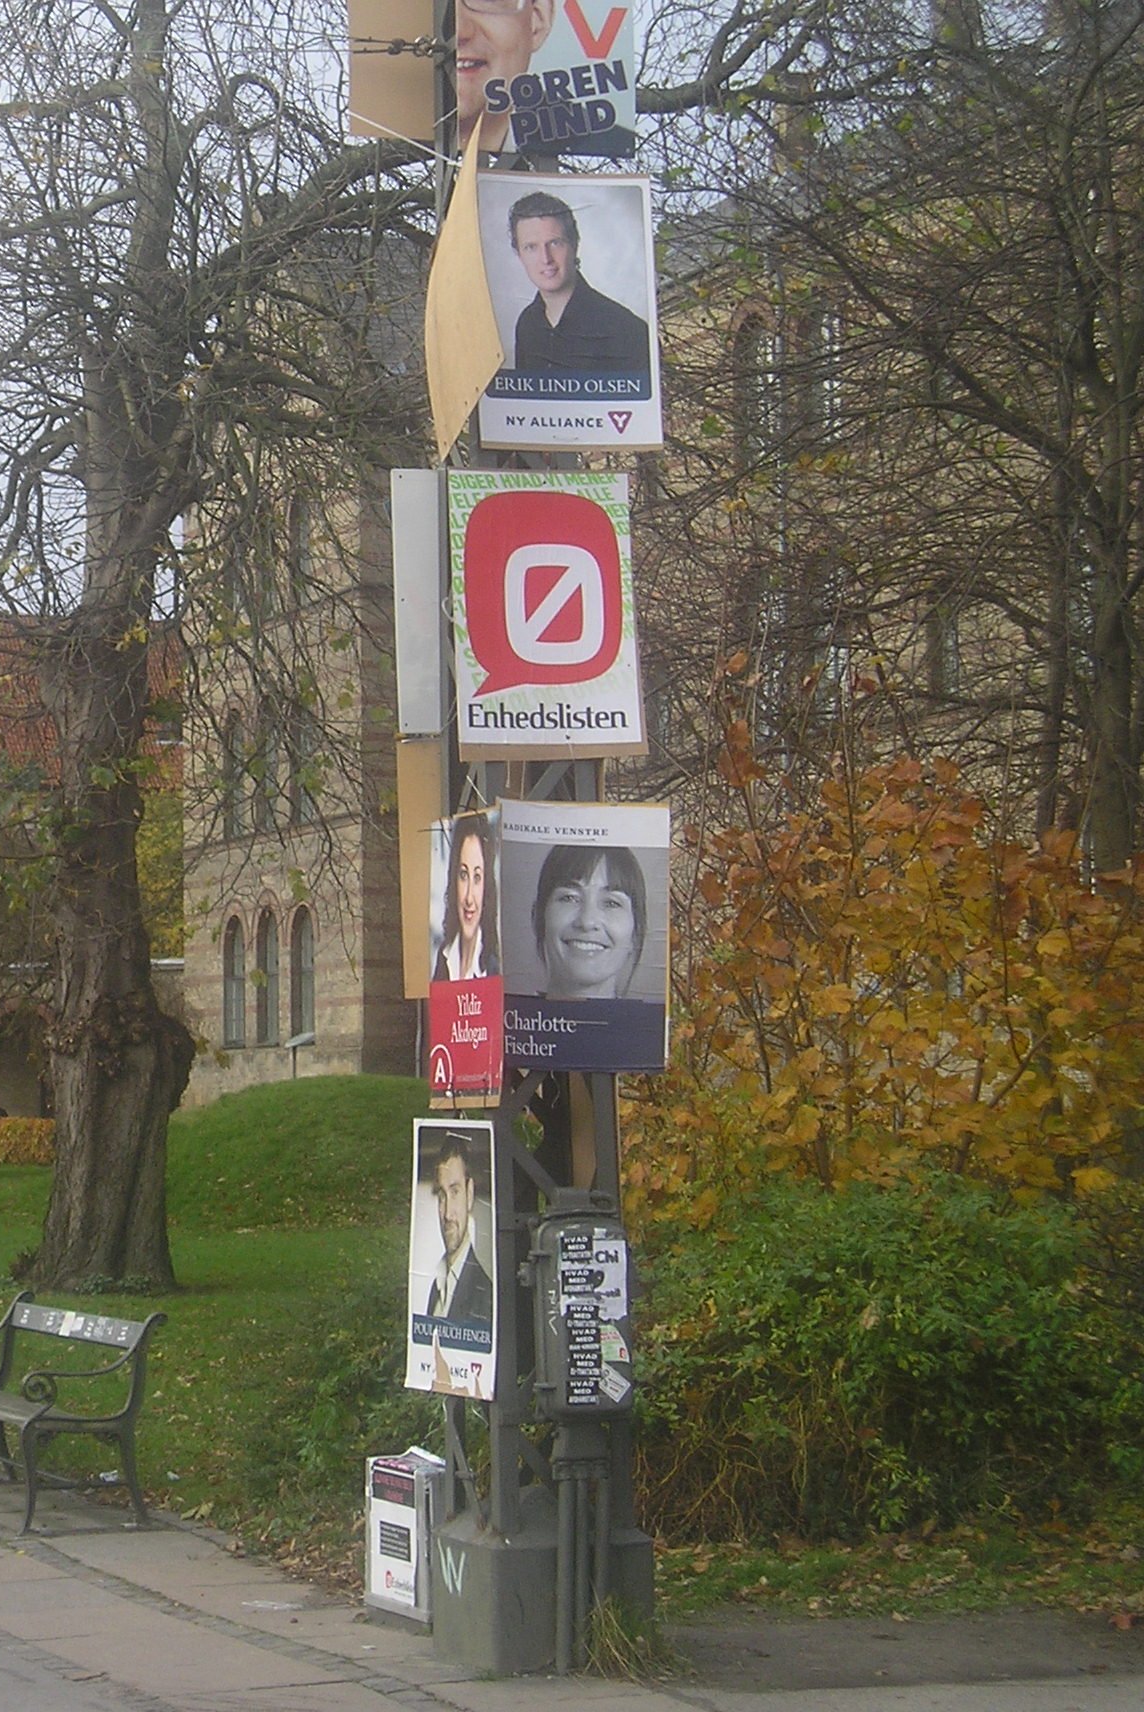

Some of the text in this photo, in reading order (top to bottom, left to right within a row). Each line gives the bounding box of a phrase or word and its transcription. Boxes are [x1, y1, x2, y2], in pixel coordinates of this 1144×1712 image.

[563, 0, 628, 59] V
[485, 60, 628, 112] SØREN
[510, 99, 616, 147] PIND
[494, 376, 641, 393] ERIK LIND OLSEN
[506, 415, 525, 426] NY
[530, 416, 604, 428] ALLIANCE
[449, 472, 619, 489] SIGER HVAD VI MENER
[504, 543, 605, 666] Ø
[467, 702, 629, 729] Enhedslisten
[503, 822, 609, 837] RADIKALE VENSTRE
[504, 1010, 577, 1034] Charlotte
[504, 1035, 557, 1056] Fischer
[434, 1058, 447, 1083] A
[420, 1362, 431, 1373] NY
